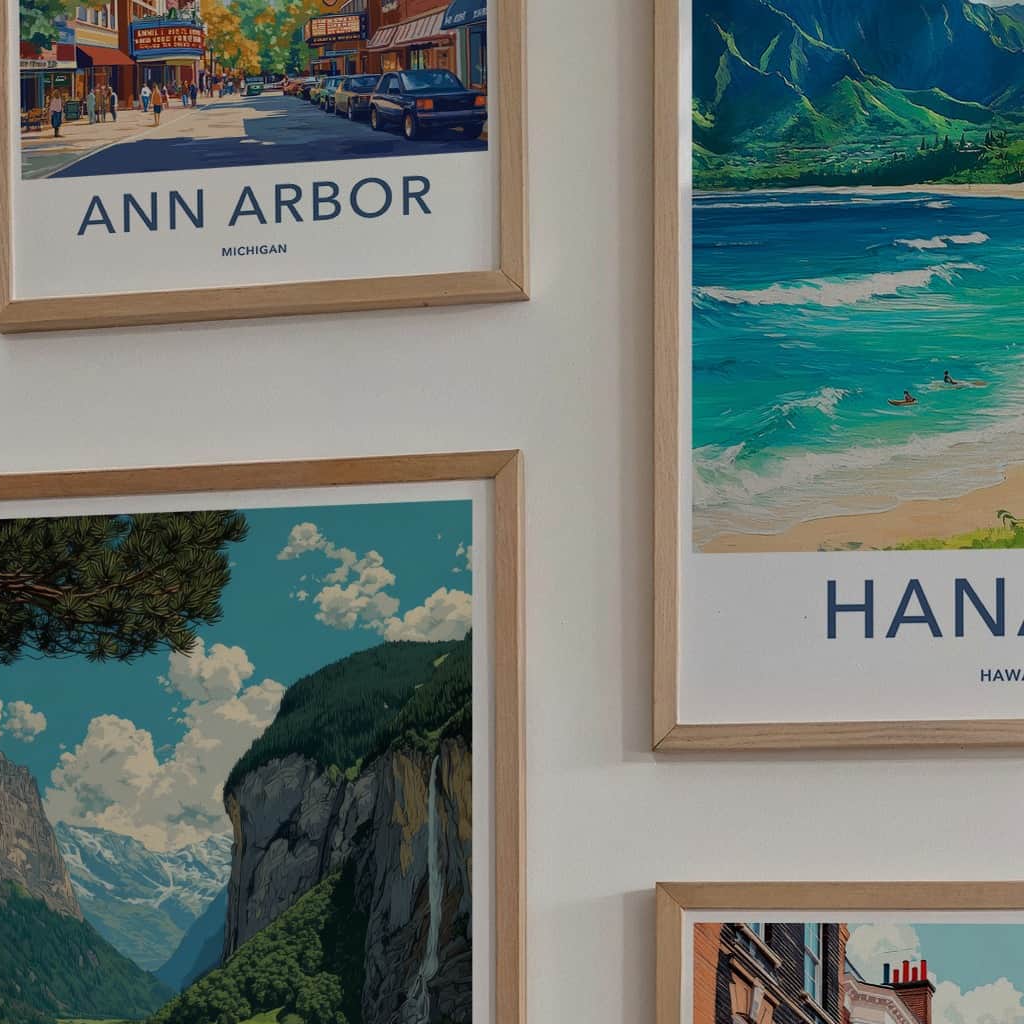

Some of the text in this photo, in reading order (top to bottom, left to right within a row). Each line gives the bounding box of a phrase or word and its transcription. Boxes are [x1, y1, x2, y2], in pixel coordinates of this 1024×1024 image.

[77, 175, 432, 236] ANN ARBOR
[221, 244, 287, 257] MICHIGAN
[826, 578, 1024, 639] HAN
[980, 669, 1024, 682] HAW
